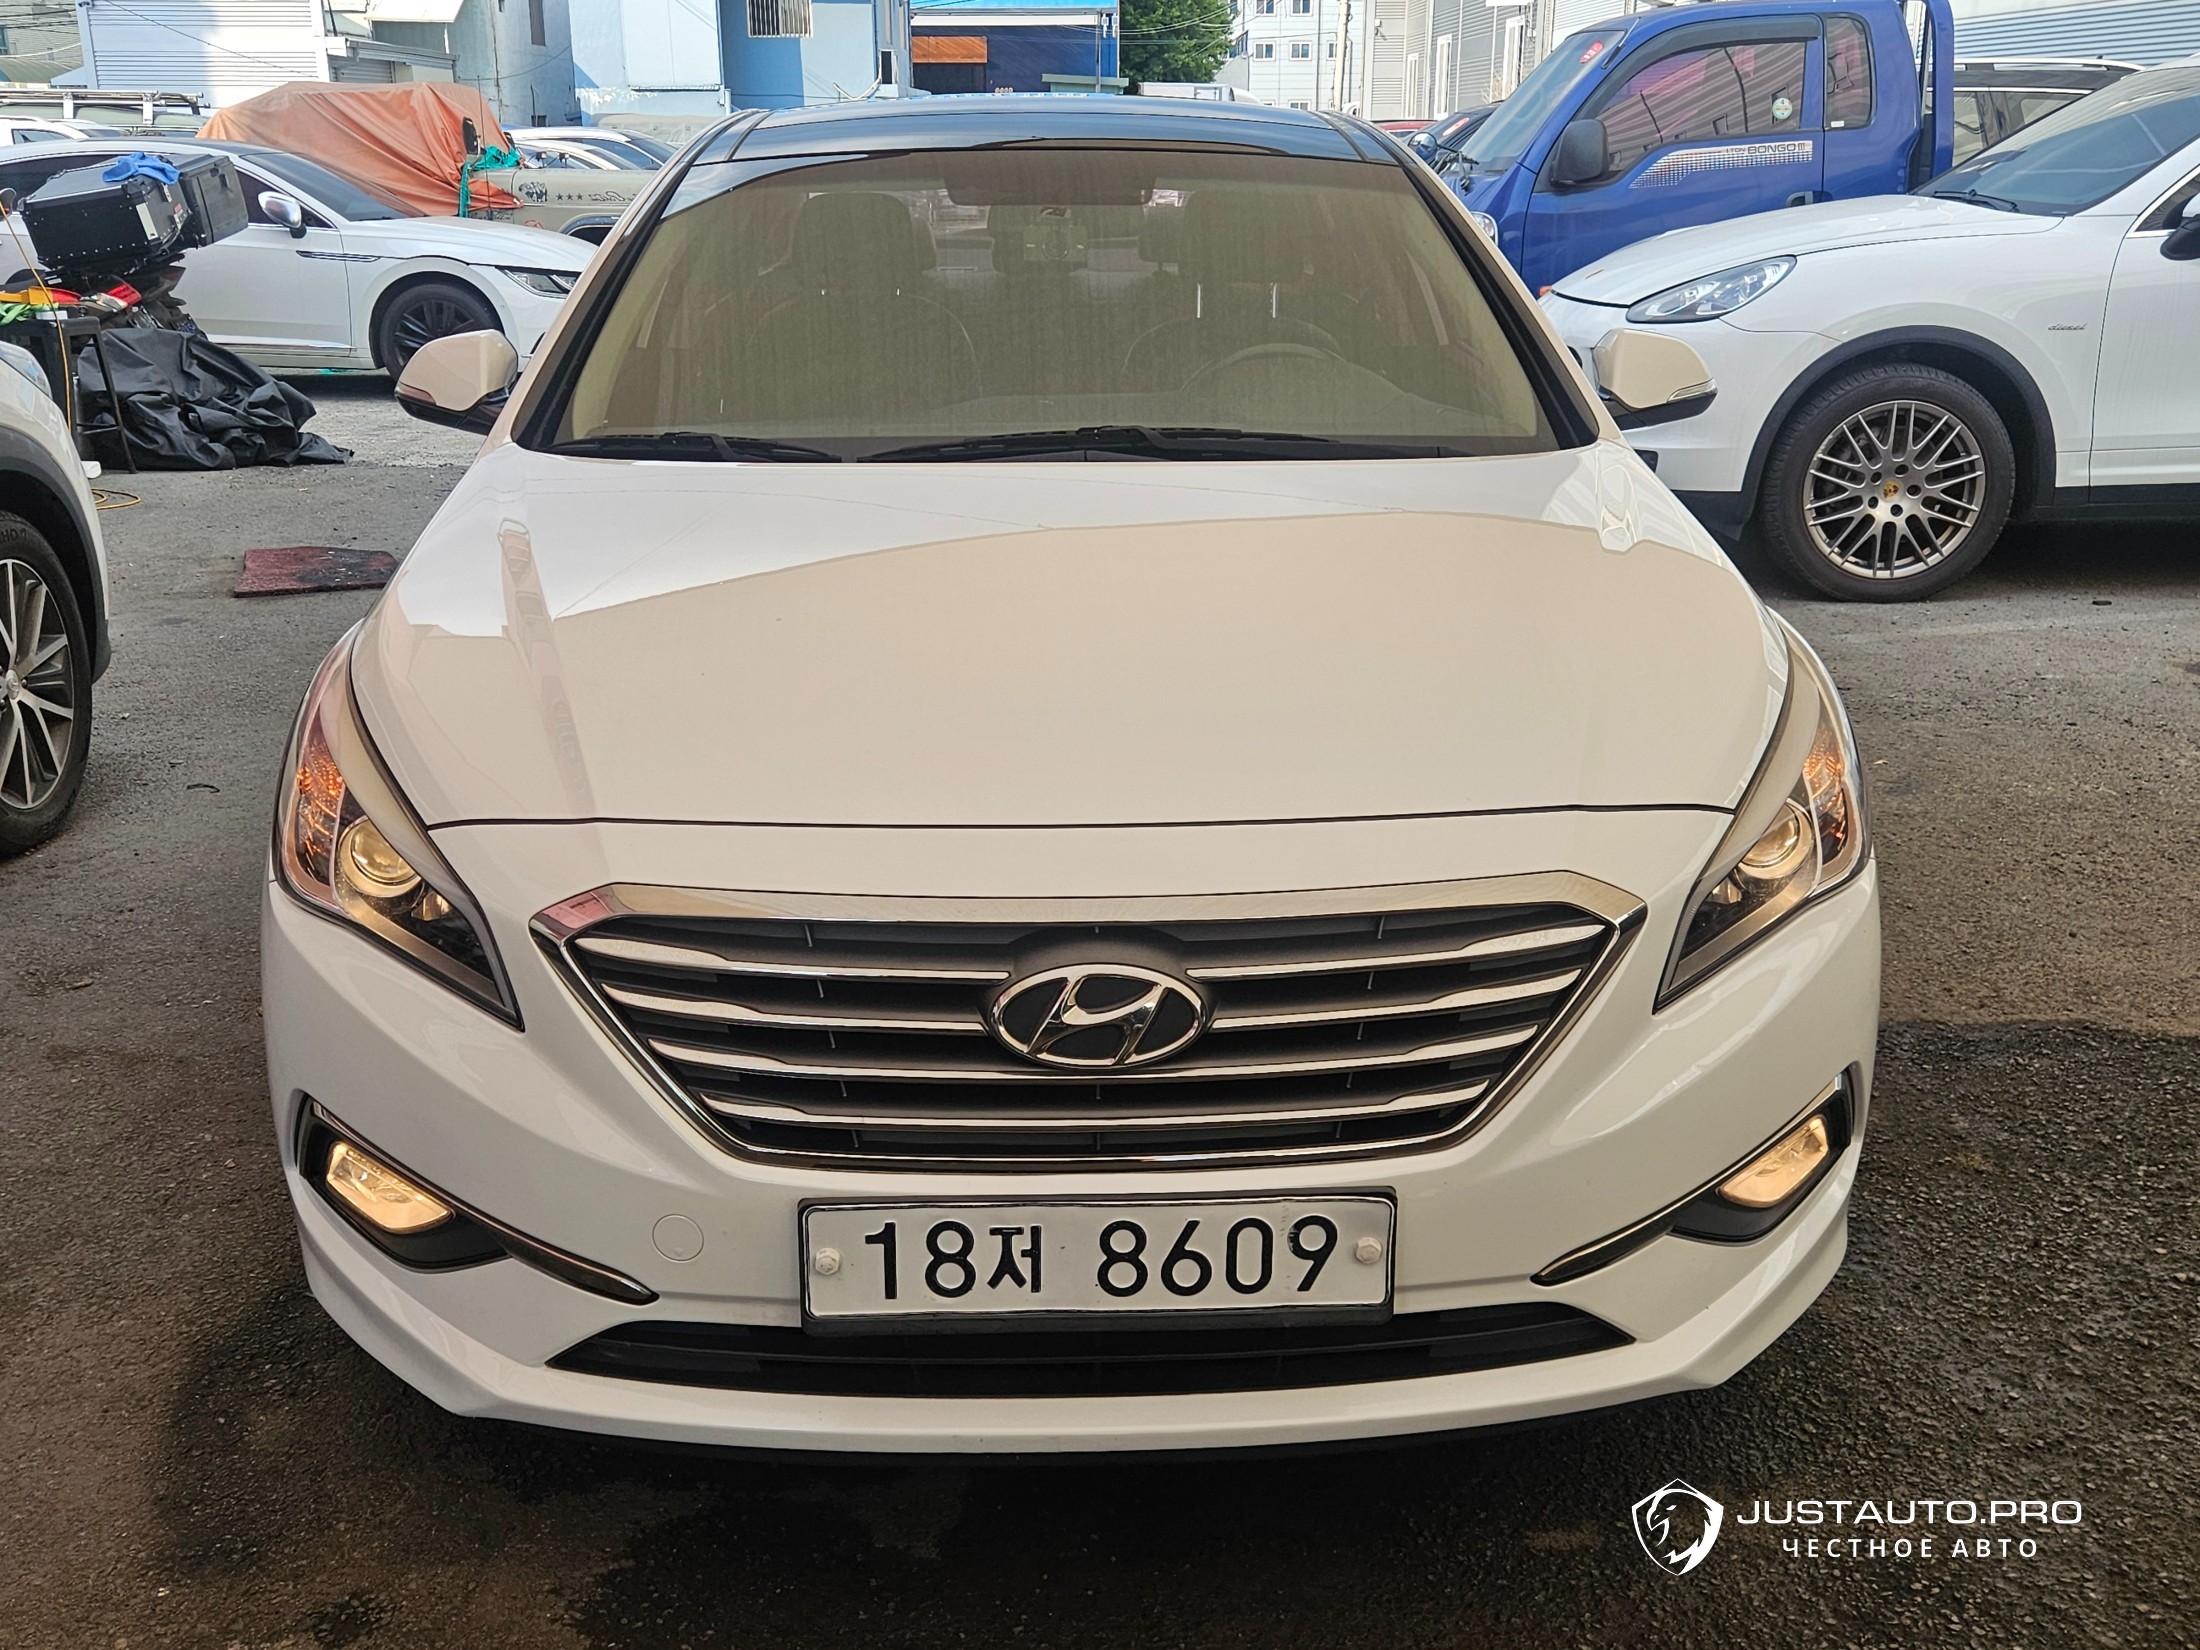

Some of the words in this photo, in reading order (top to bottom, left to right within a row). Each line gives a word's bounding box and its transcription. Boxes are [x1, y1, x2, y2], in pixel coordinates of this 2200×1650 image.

[1747, 143, 1797, 155] BONGO
[863, 1220, 1042, 1300] 18저
[1096, 1214, 1338, 1298] 8609
